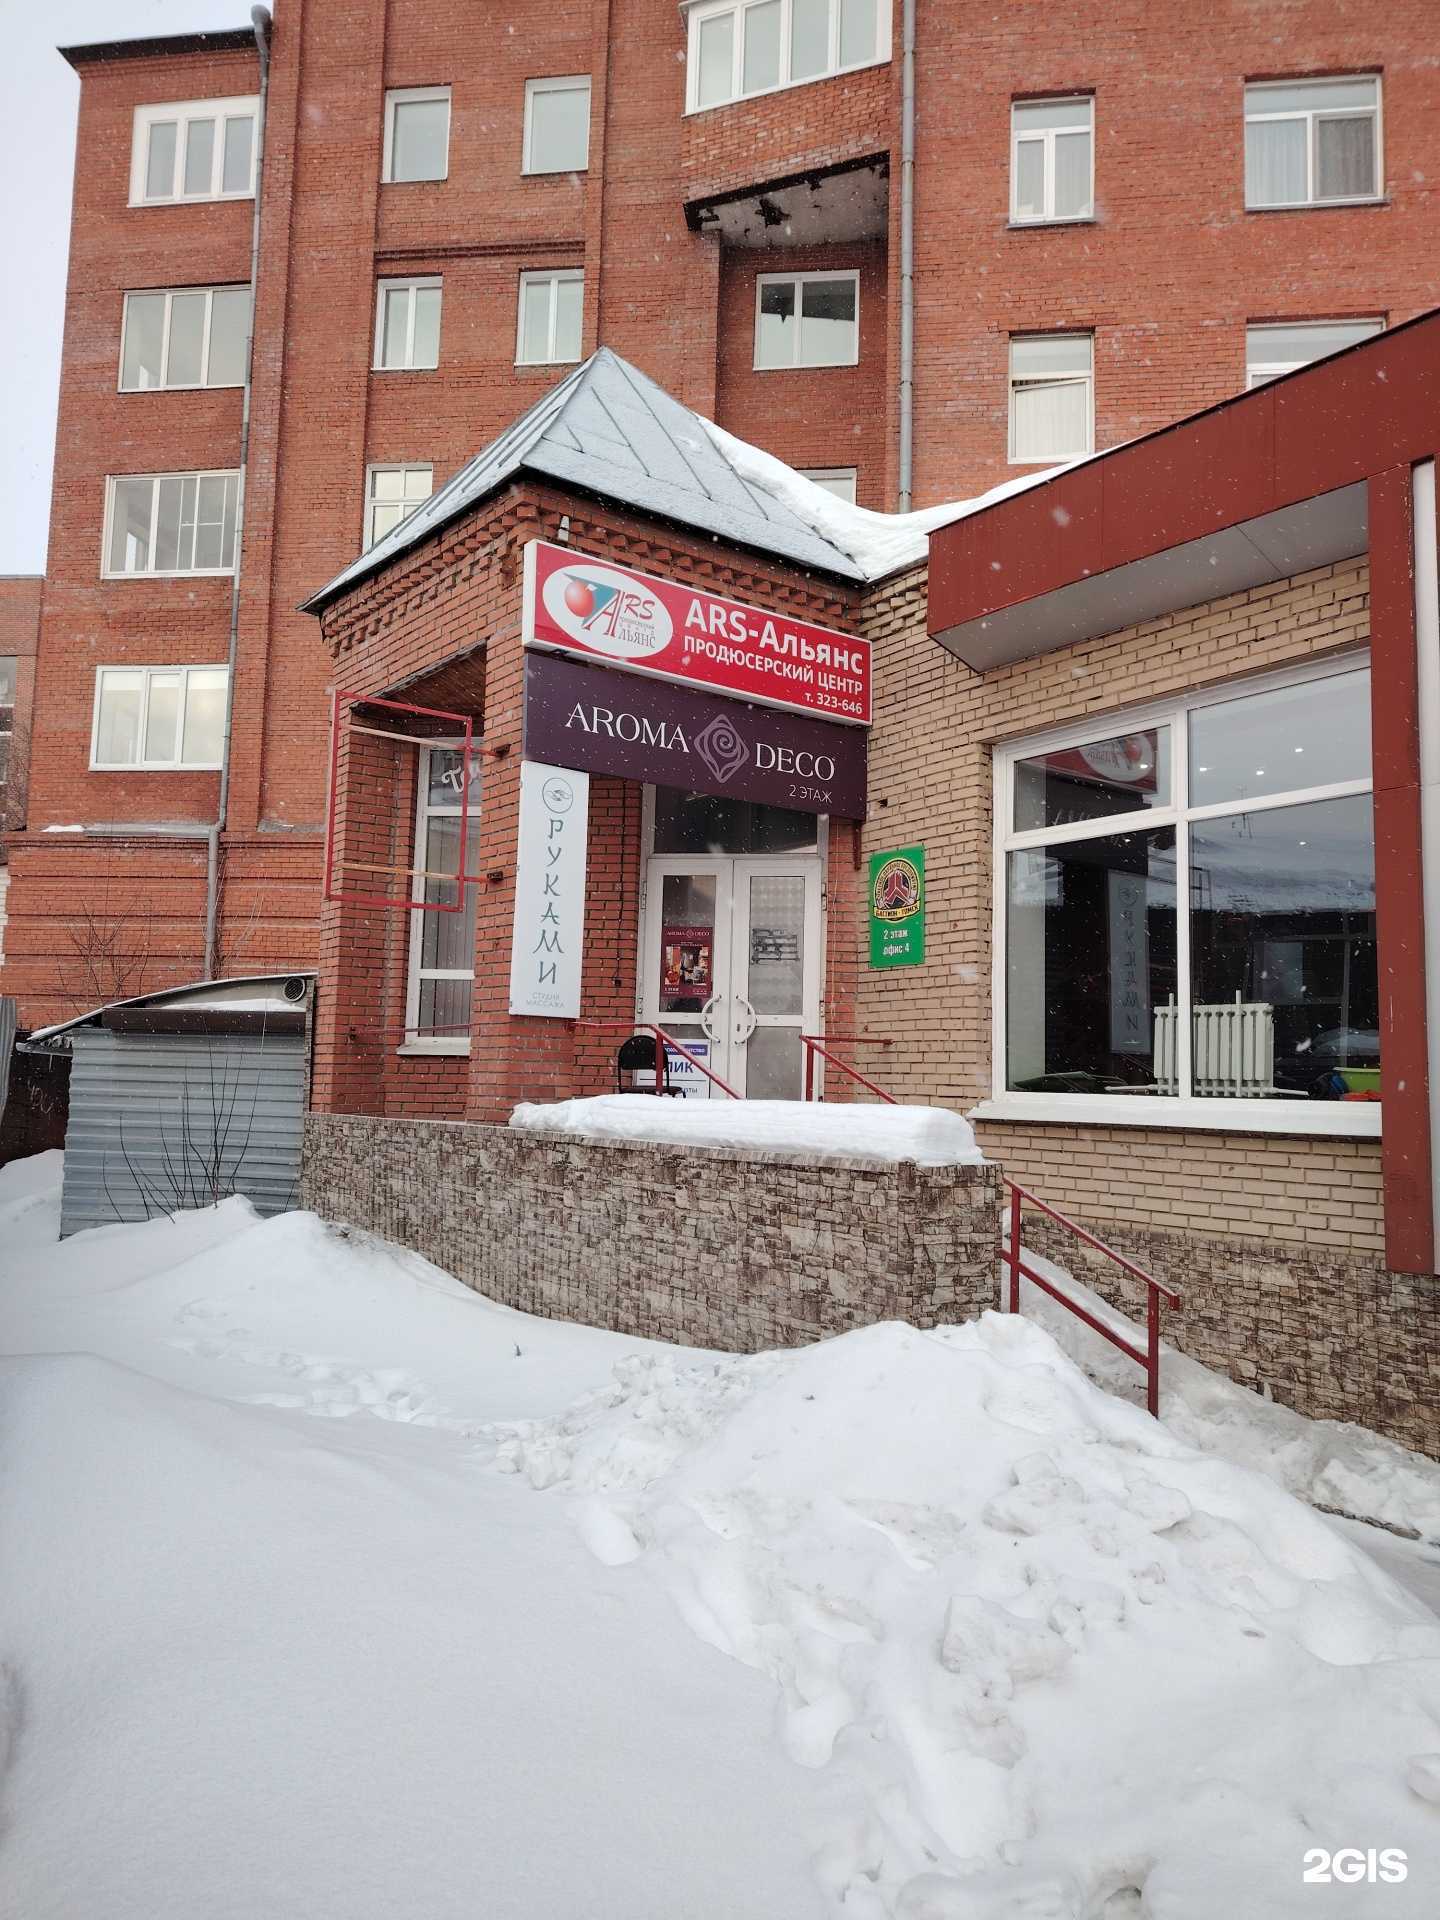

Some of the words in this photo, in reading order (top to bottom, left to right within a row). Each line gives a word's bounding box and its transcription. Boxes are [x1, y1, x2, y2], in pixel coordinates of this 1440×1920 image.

[684, 635, 814, 684] ПРОДЮСЕРСКИЙ
[818, 671, 863, 695] ЦЕНТР
[816, 693, 863, 714] 323-646
[565, 702, 690, 753] AROMA
[755, 742, 835, 780] DECO
[789, 784, 797, 797] 2
[800, 786, 833, 804] ЭТАЖ
[532, 819, 565, 985] РУКАМИ
[883, 929, 889, 940] 2
[882, 944, 903, 957] офис
[904, 943, 910, 953] 4
